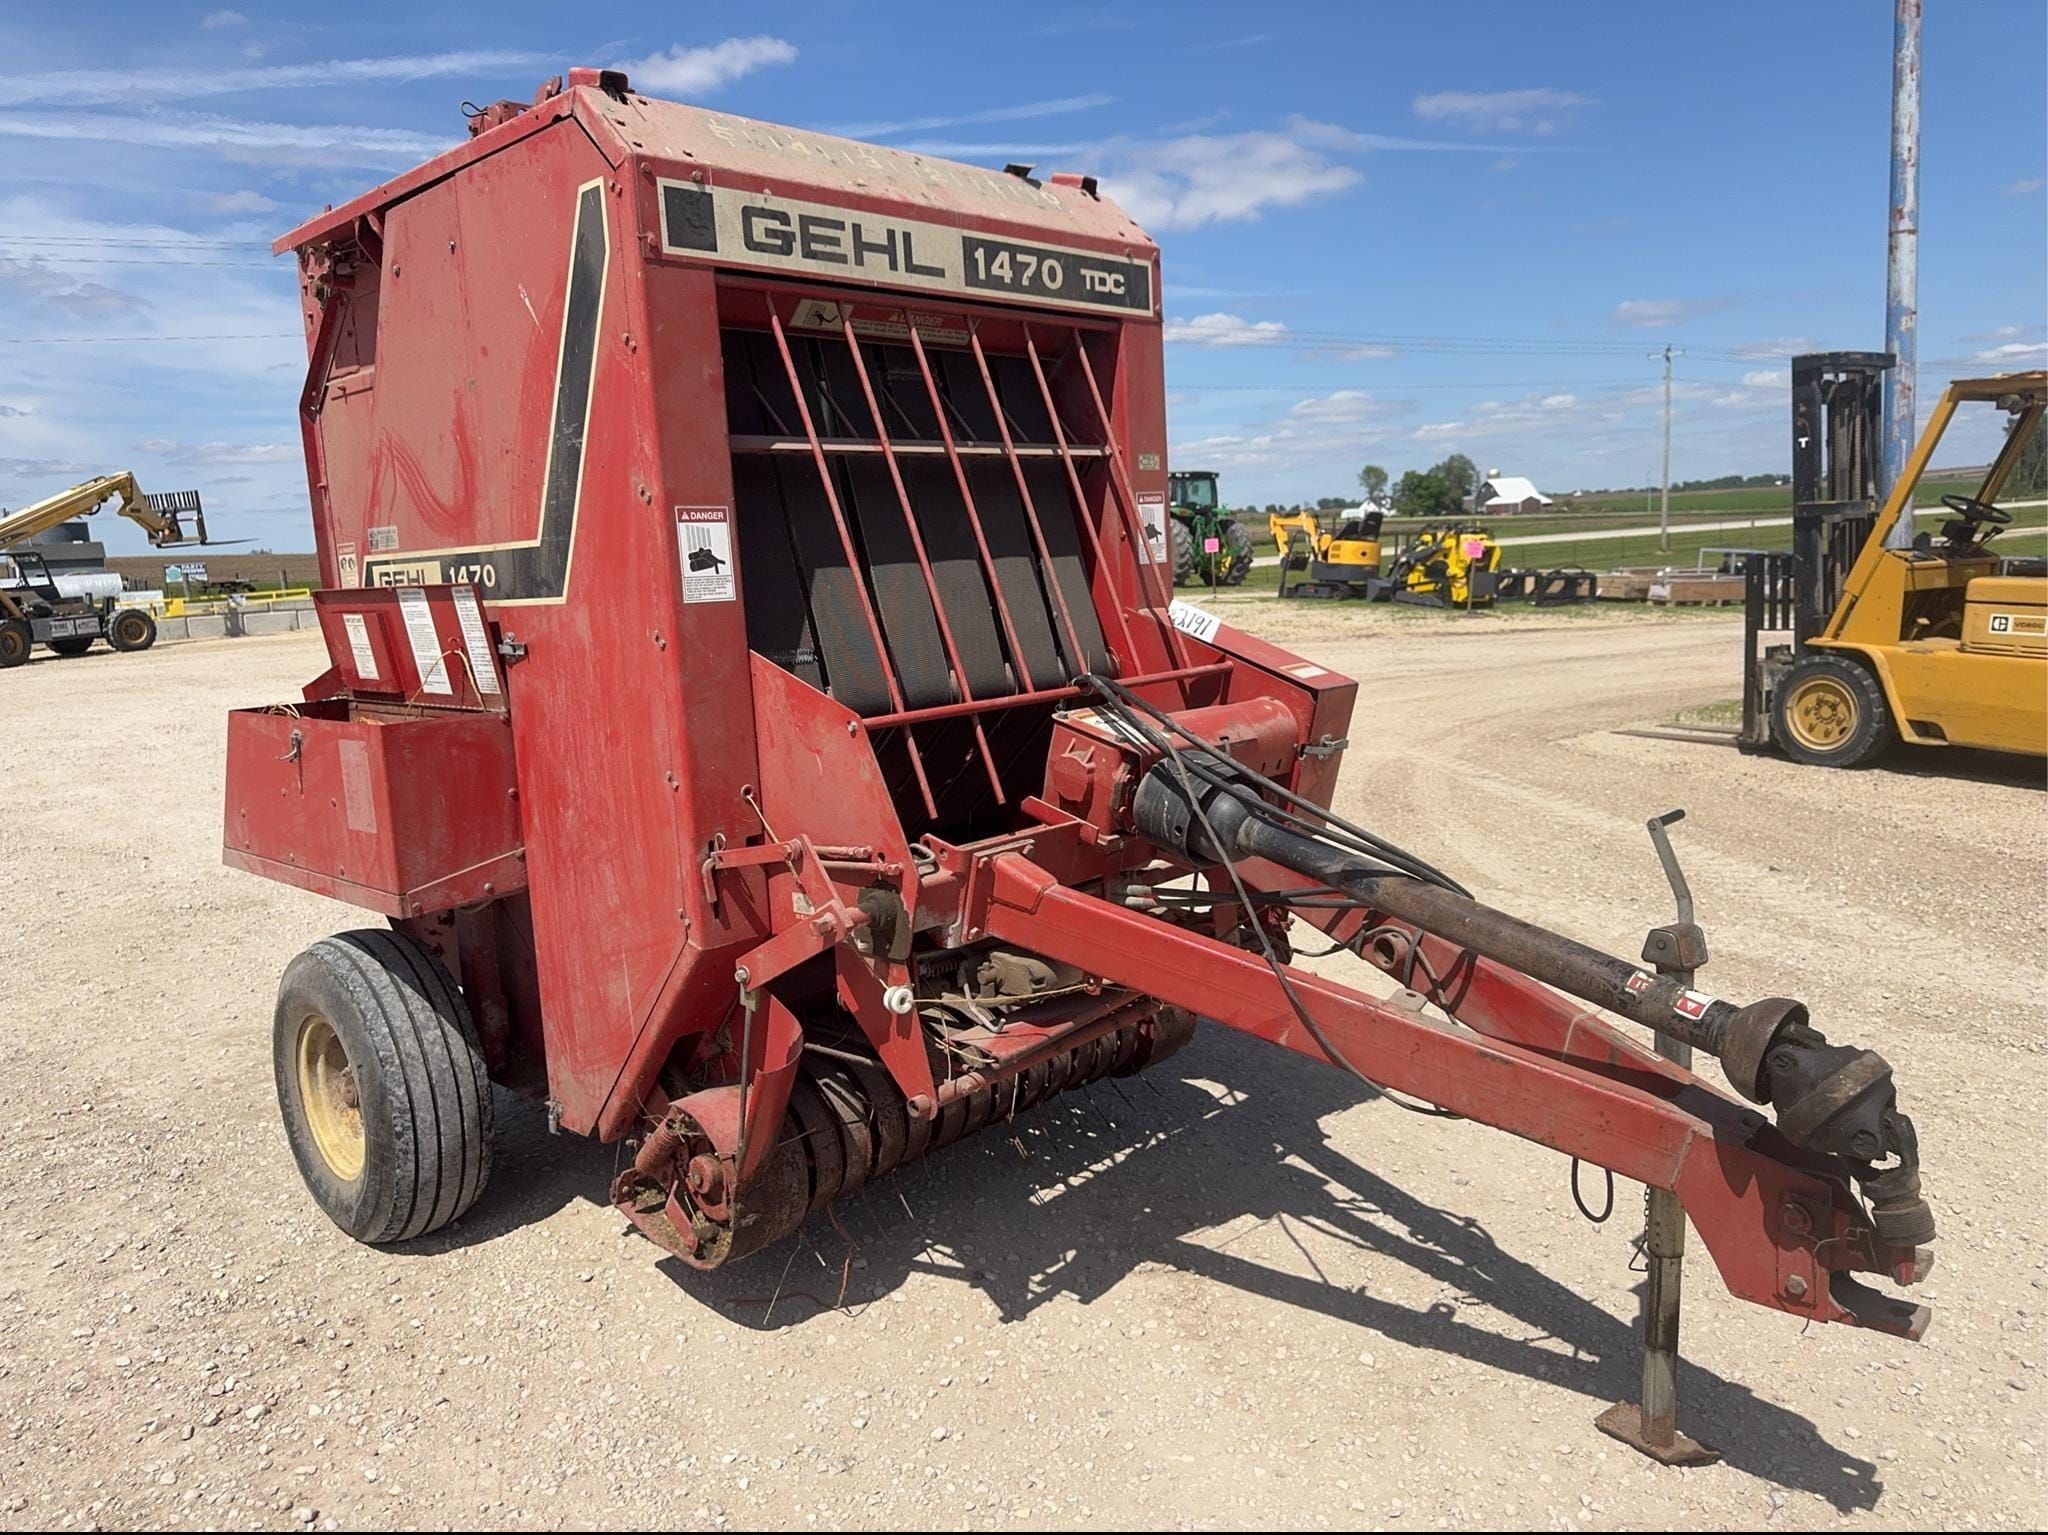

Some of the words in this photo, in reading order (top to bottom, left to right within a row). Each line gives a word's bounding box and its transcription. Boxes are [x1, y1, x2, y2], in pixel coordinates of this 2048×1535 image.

[741, 205, 946, 279] GEHL
[973, 246, 1064, 291] 1470
[1080, 267, 1126, 296] TDC
[690, 511, 724, 520] DANGER
[449, 563, 496, 589] 1470
